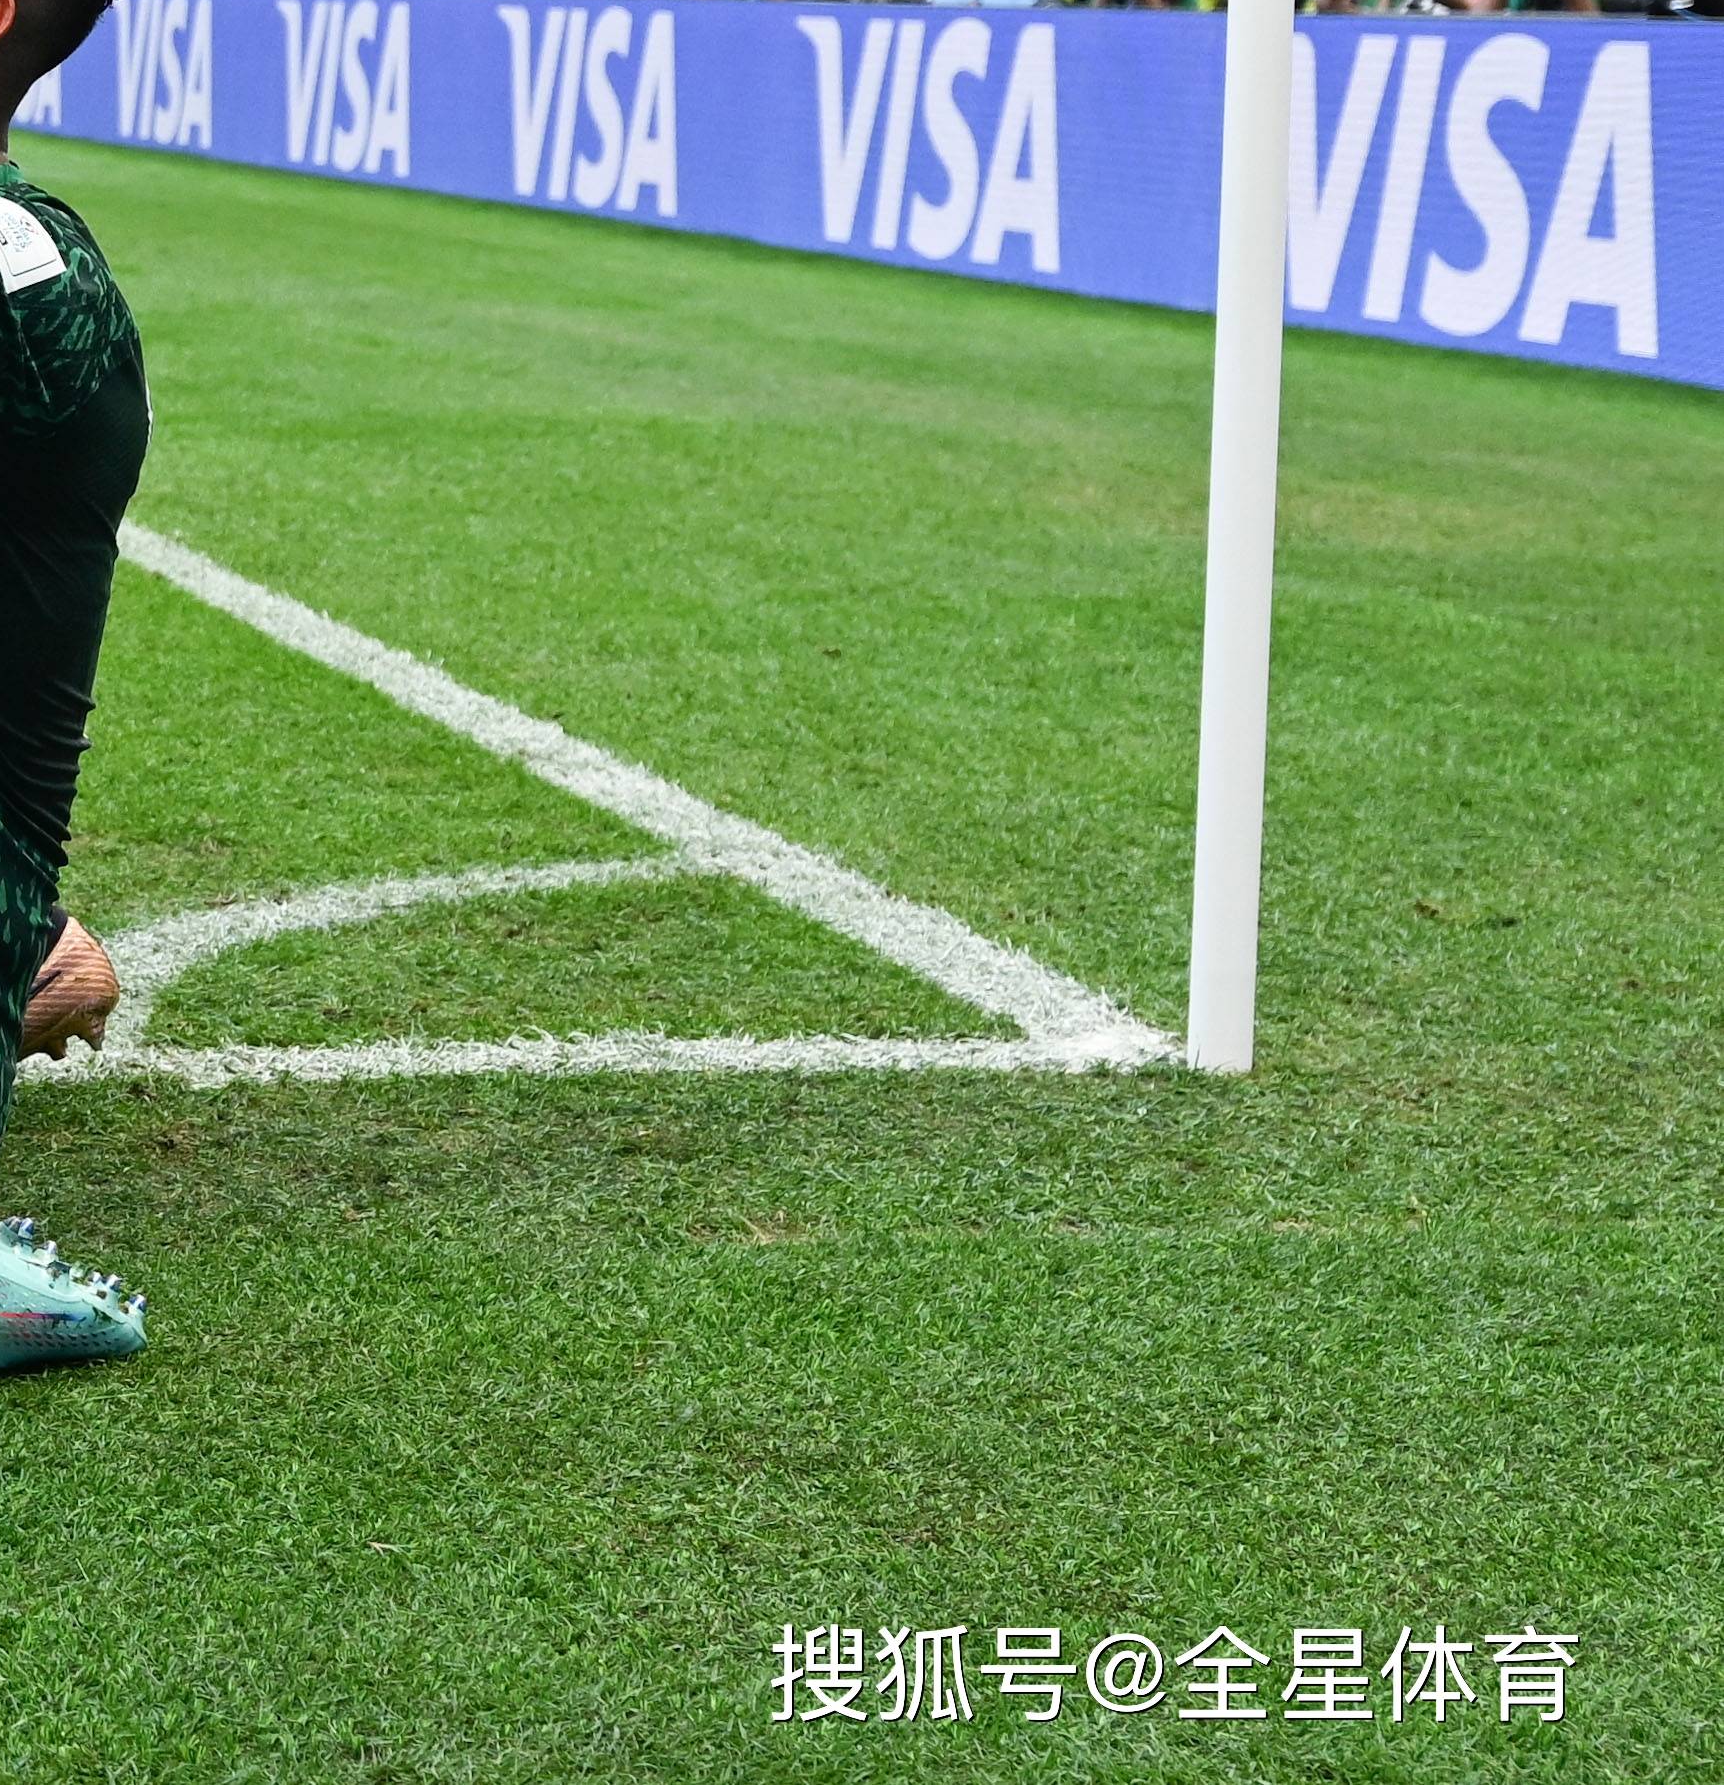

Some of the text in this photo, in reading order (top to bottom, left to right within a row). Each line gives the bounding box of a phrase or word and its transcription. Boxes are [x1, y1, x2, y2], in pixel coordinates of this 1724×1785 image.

[277, 0, 411, 178] VISA
[499, 5, 677, 217] VISA
[797, 15, 1060, 274] VISA
[1287, 32, 1659, 360] VISA
